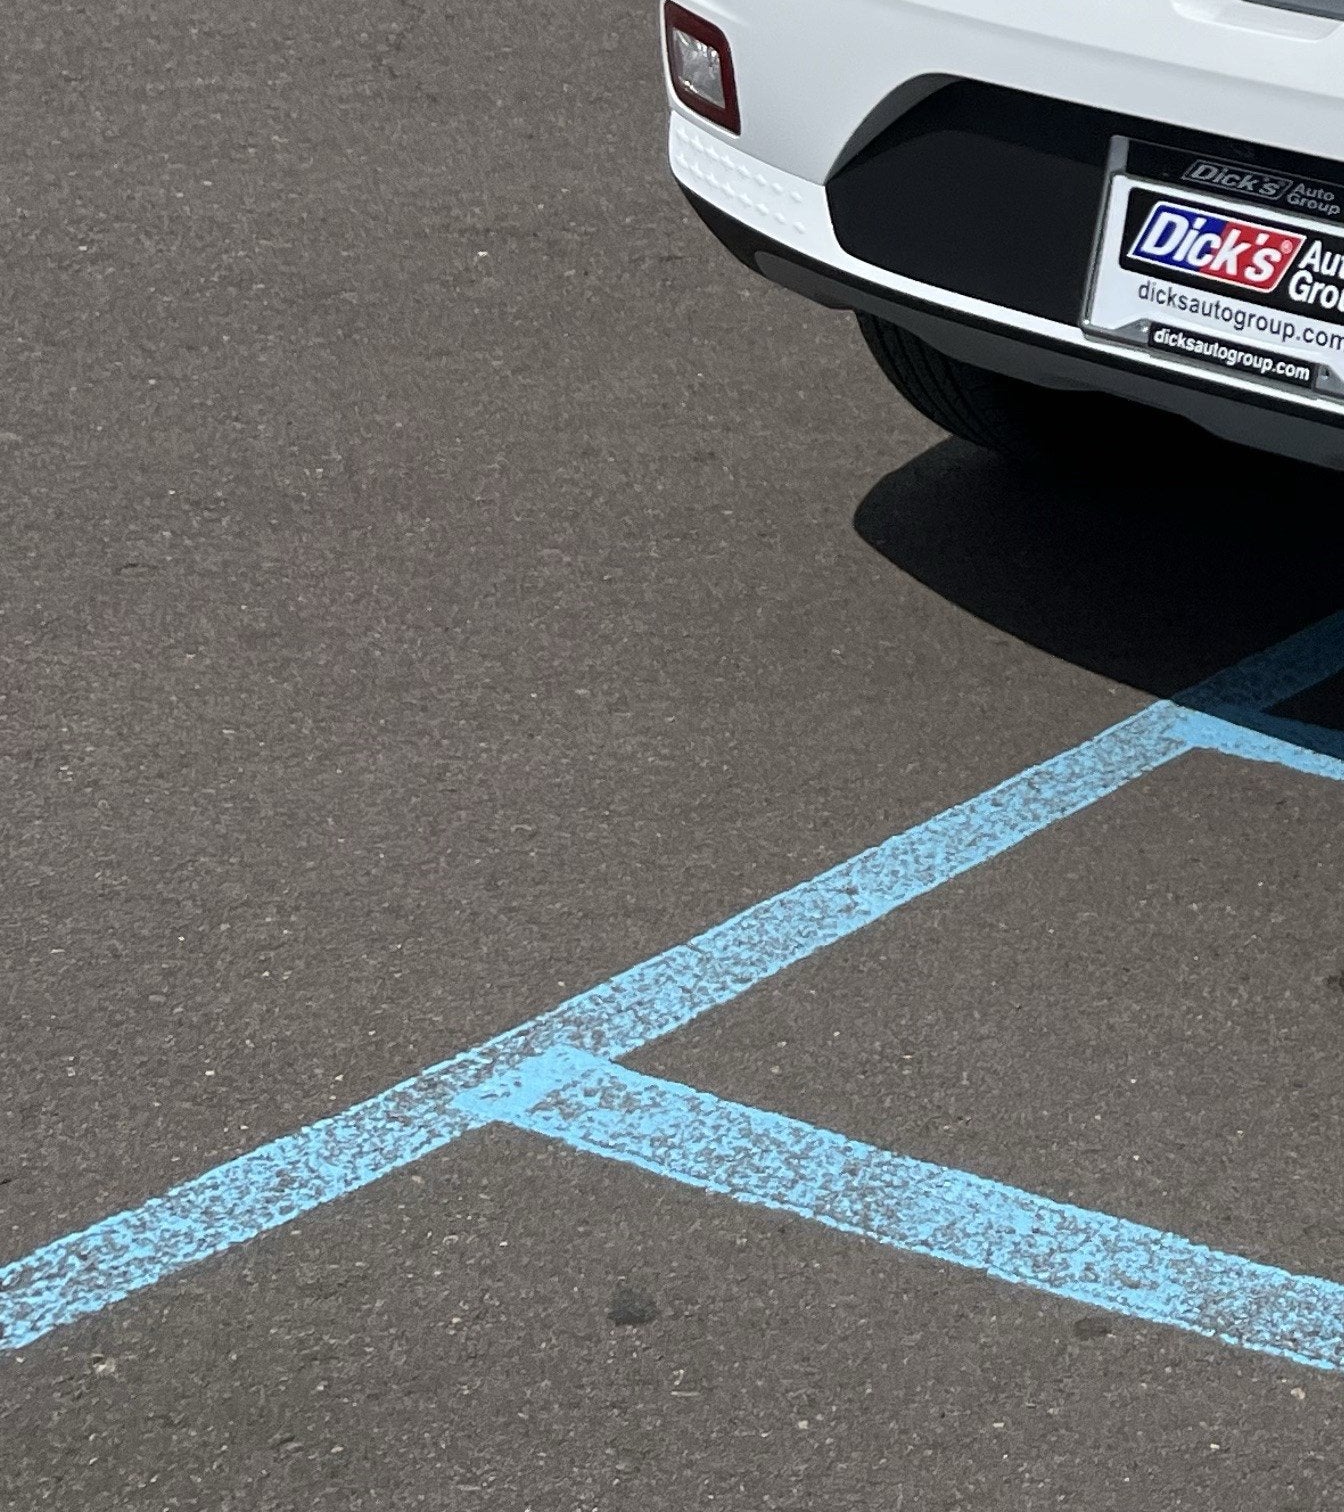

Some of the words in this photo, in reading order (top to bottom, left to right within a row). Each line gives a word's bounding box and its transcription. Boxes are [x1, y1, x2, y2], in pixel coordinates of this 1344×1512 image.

[1191, 164, 1280, 196] Dick's
[1293, 183, 1335, 201] Auto
[1287, 192, 1341, 215] Group
[1141, 211, 1282, 283] Dick's
[1153, 328, 1310, 382] dicksautogroup.com
